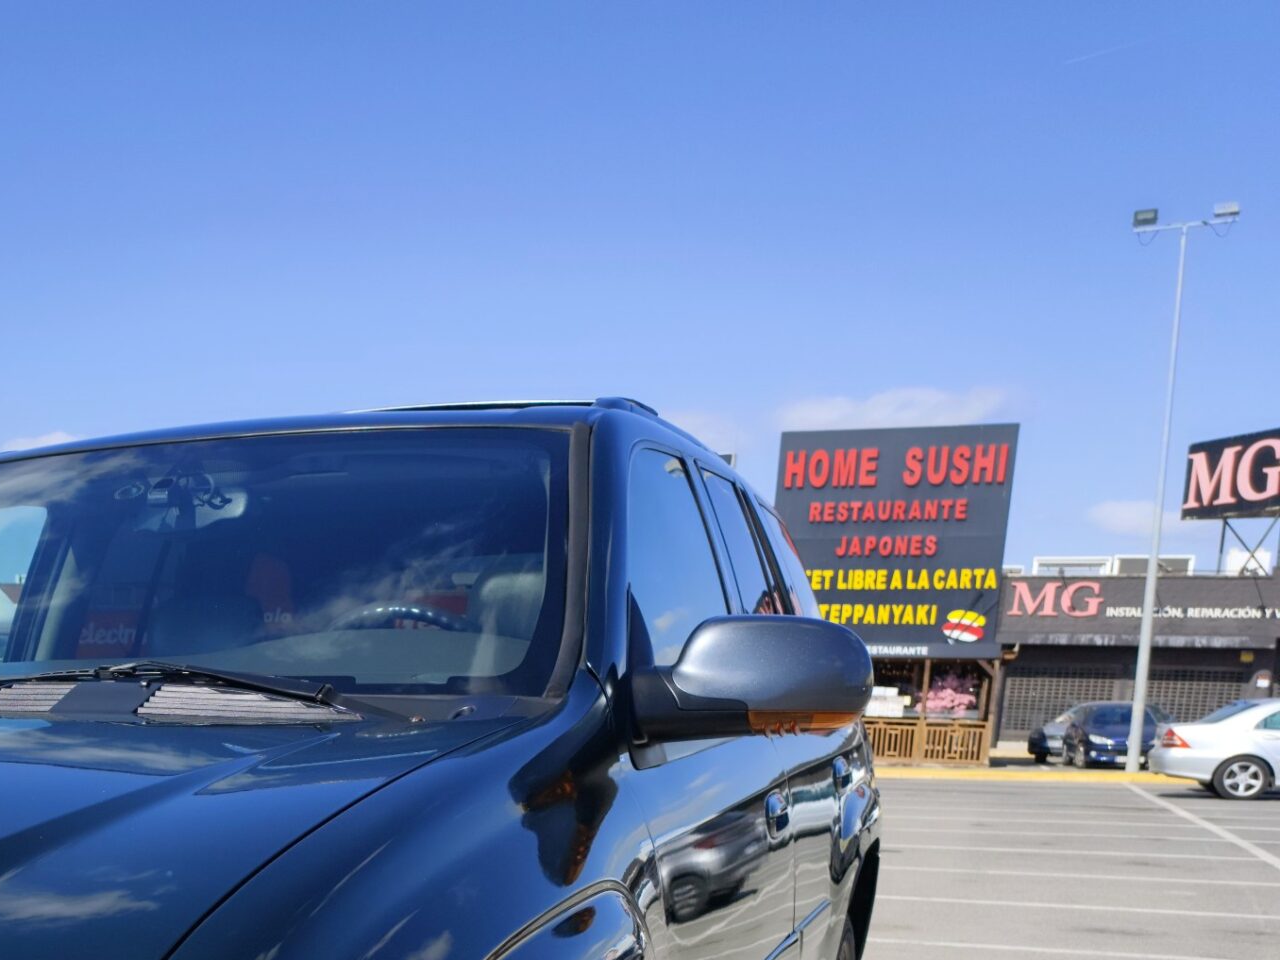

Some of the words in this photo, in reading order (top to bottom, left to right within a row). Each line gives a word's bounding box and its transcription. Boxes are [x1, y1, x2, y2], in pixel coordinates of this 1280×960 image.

[784, 448, 879, 489] HOME
[902, 443, 1009, 487] SUSHI
[1183, 438, 1280, 509] MG
[808, 498, 968, 523] RESTAURANTE
[835, 535, 938, 557] JAPONES
[837, 569, 888, 590] LIBRE
[890, 569, 902, 590] A
[906, 569, 931, 590] LA
[933, 568, 998, 590] CARTA
[1007, 581, 1104, 618] MG
[819, 603, 937, 625] TEPPANYAKI
[1106, 605, 1184, 618] INSTALCIÓN,
[1187, 605, 1262, 618] REPARACIÓN
